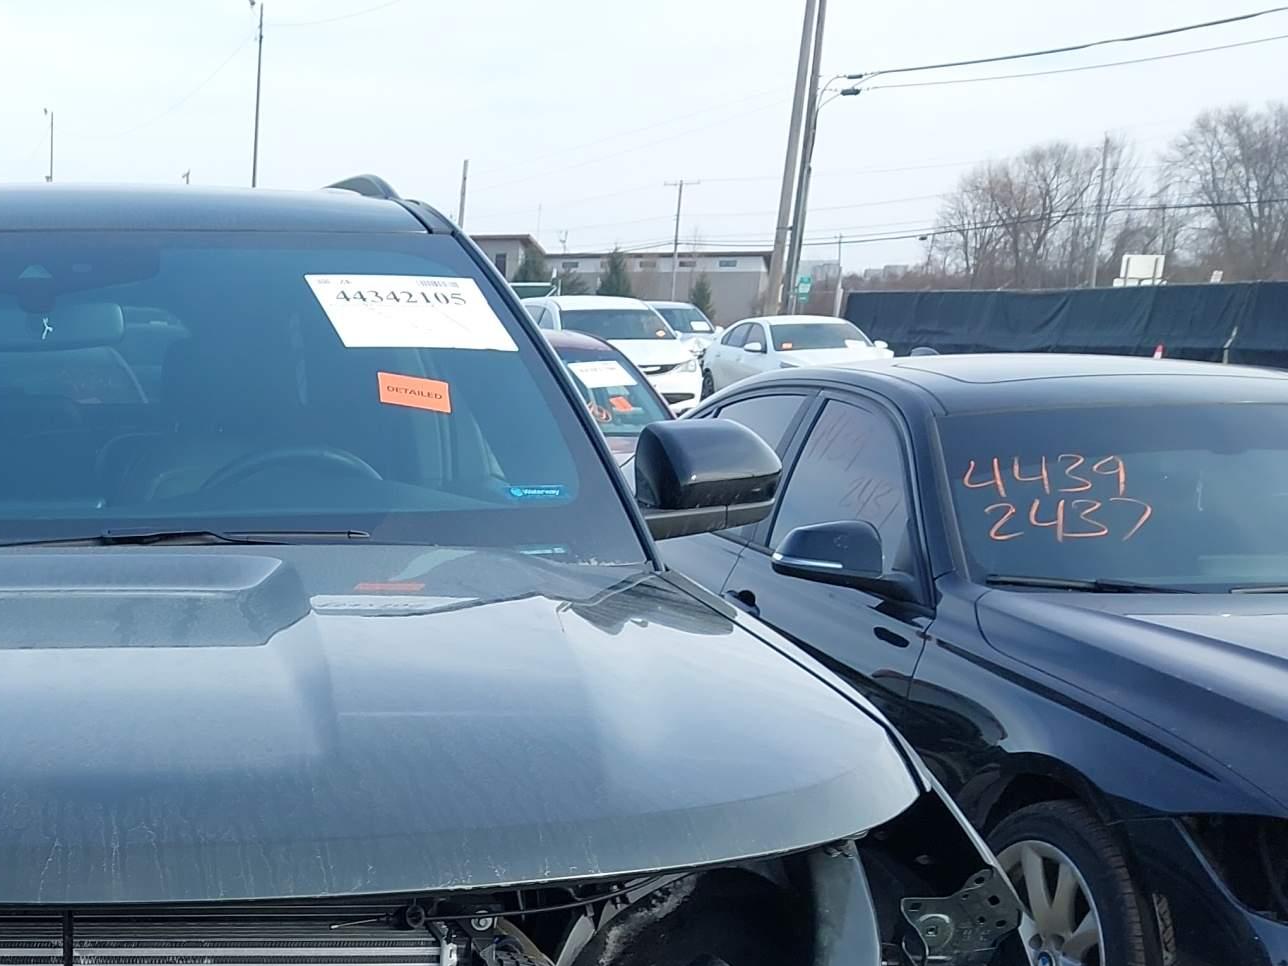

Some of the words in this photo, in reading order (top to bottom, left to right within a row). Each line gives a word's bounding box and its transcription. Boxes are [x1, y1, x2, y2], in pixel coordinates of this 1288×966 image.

[336, 289, 467, 306] 44342105
[386, 384, 443, 400] DETAILED
[963, 453, 1127, 498] 4439
[984, 496, 1153, 543] 2437
